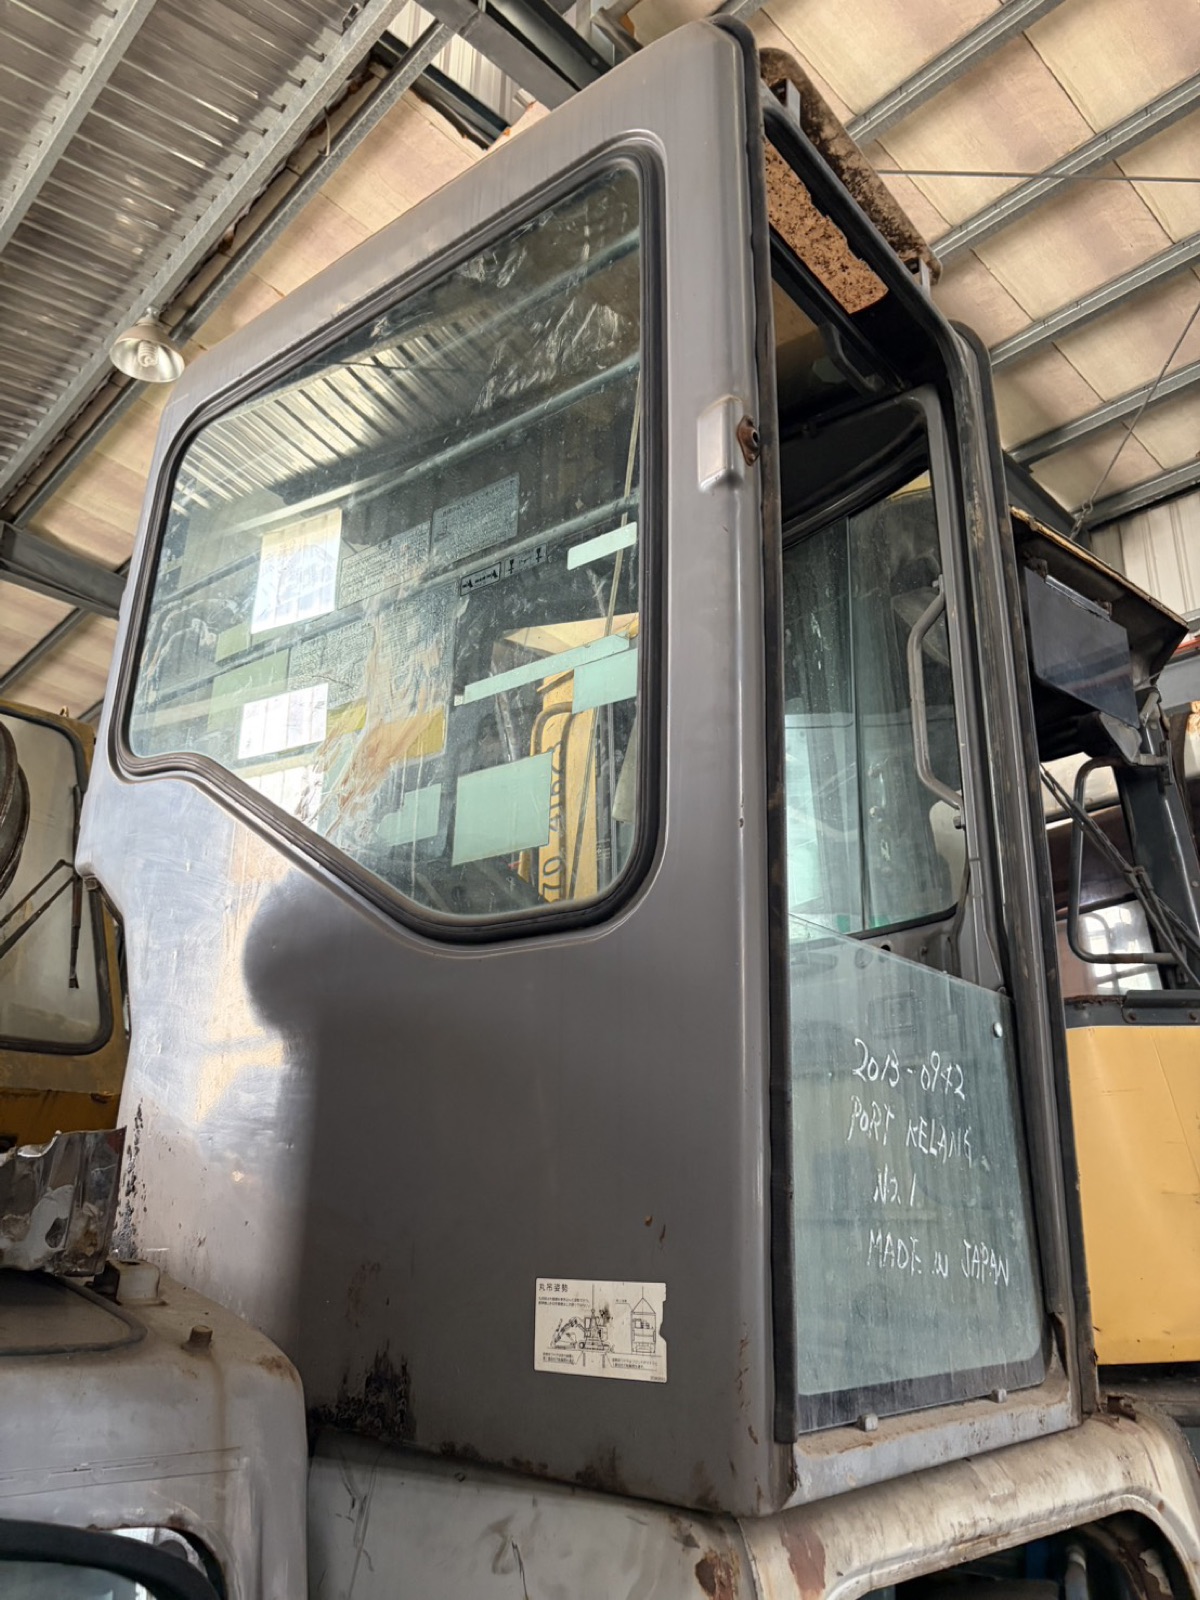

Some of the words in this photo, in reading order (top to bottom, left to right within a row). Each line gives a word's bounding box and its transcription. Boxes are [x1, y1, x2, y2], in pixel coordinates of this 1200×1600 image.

[847, 1095, 895, 1146] PORT
[867, 1228, 922, 1276] MADE
[961, 1238, 1009, 1287] JAPAN
